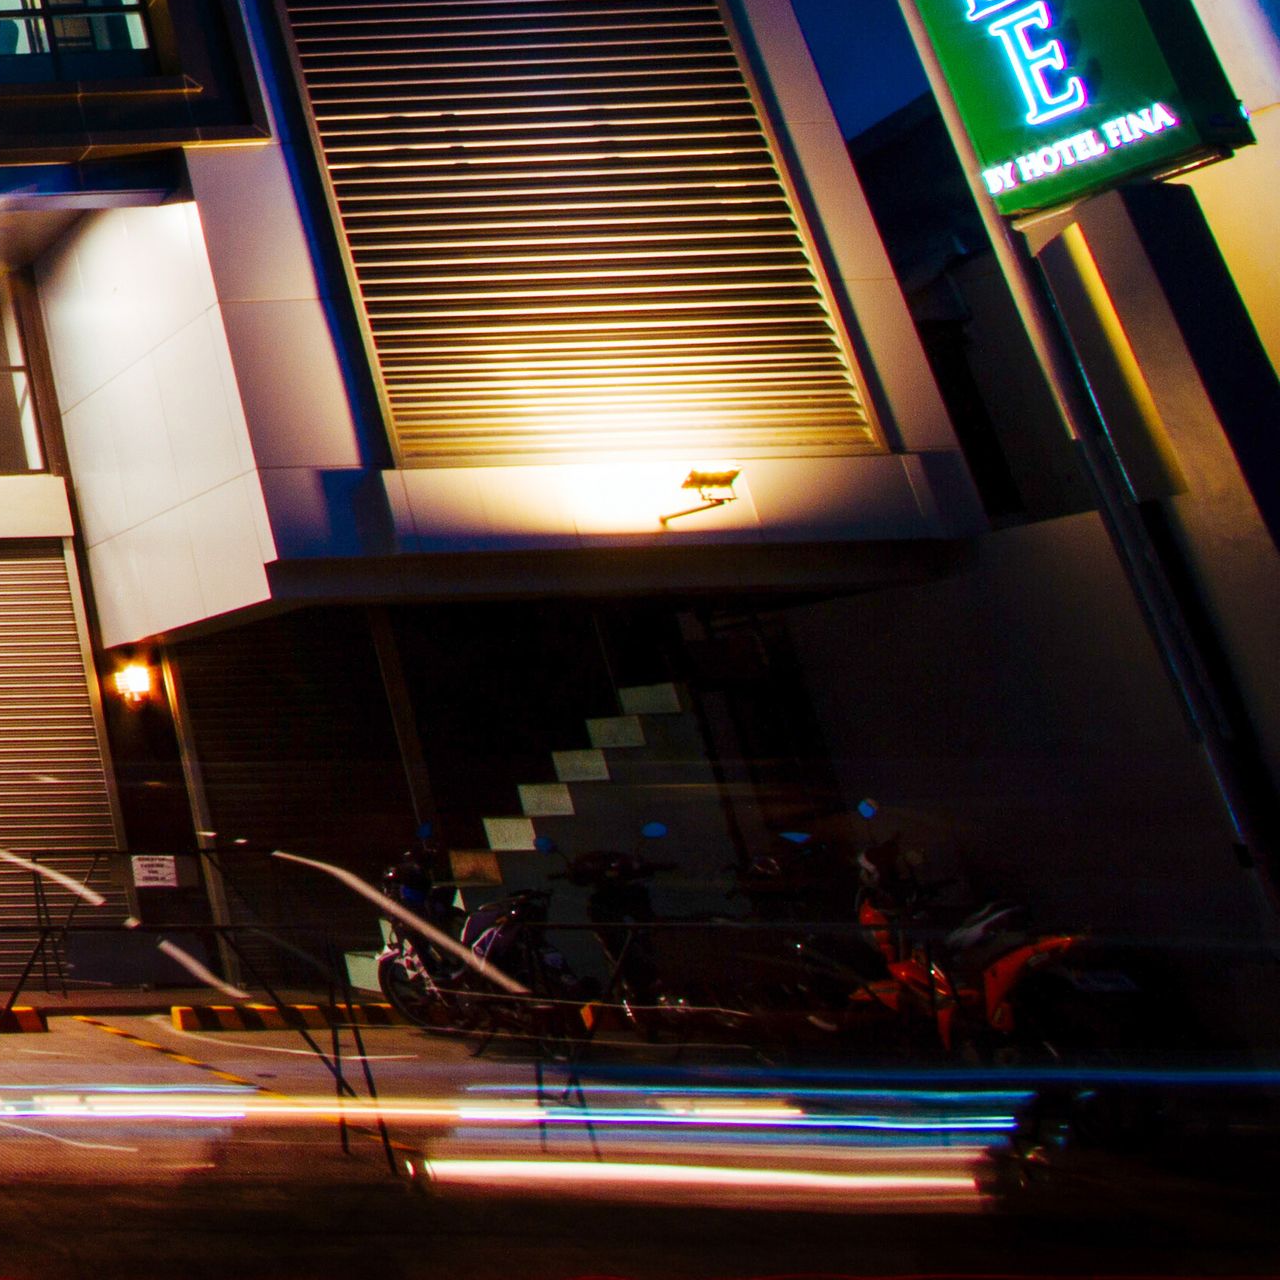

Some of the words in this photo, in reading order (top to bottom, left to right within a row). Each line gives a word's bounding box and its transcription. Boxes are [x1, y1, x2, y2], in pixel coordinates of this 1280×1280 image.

[983, 162, 1016, 194] BY
[1015, 130, 1107, 181] HOTEL
[1101, 101, 1178, 148] FINA
